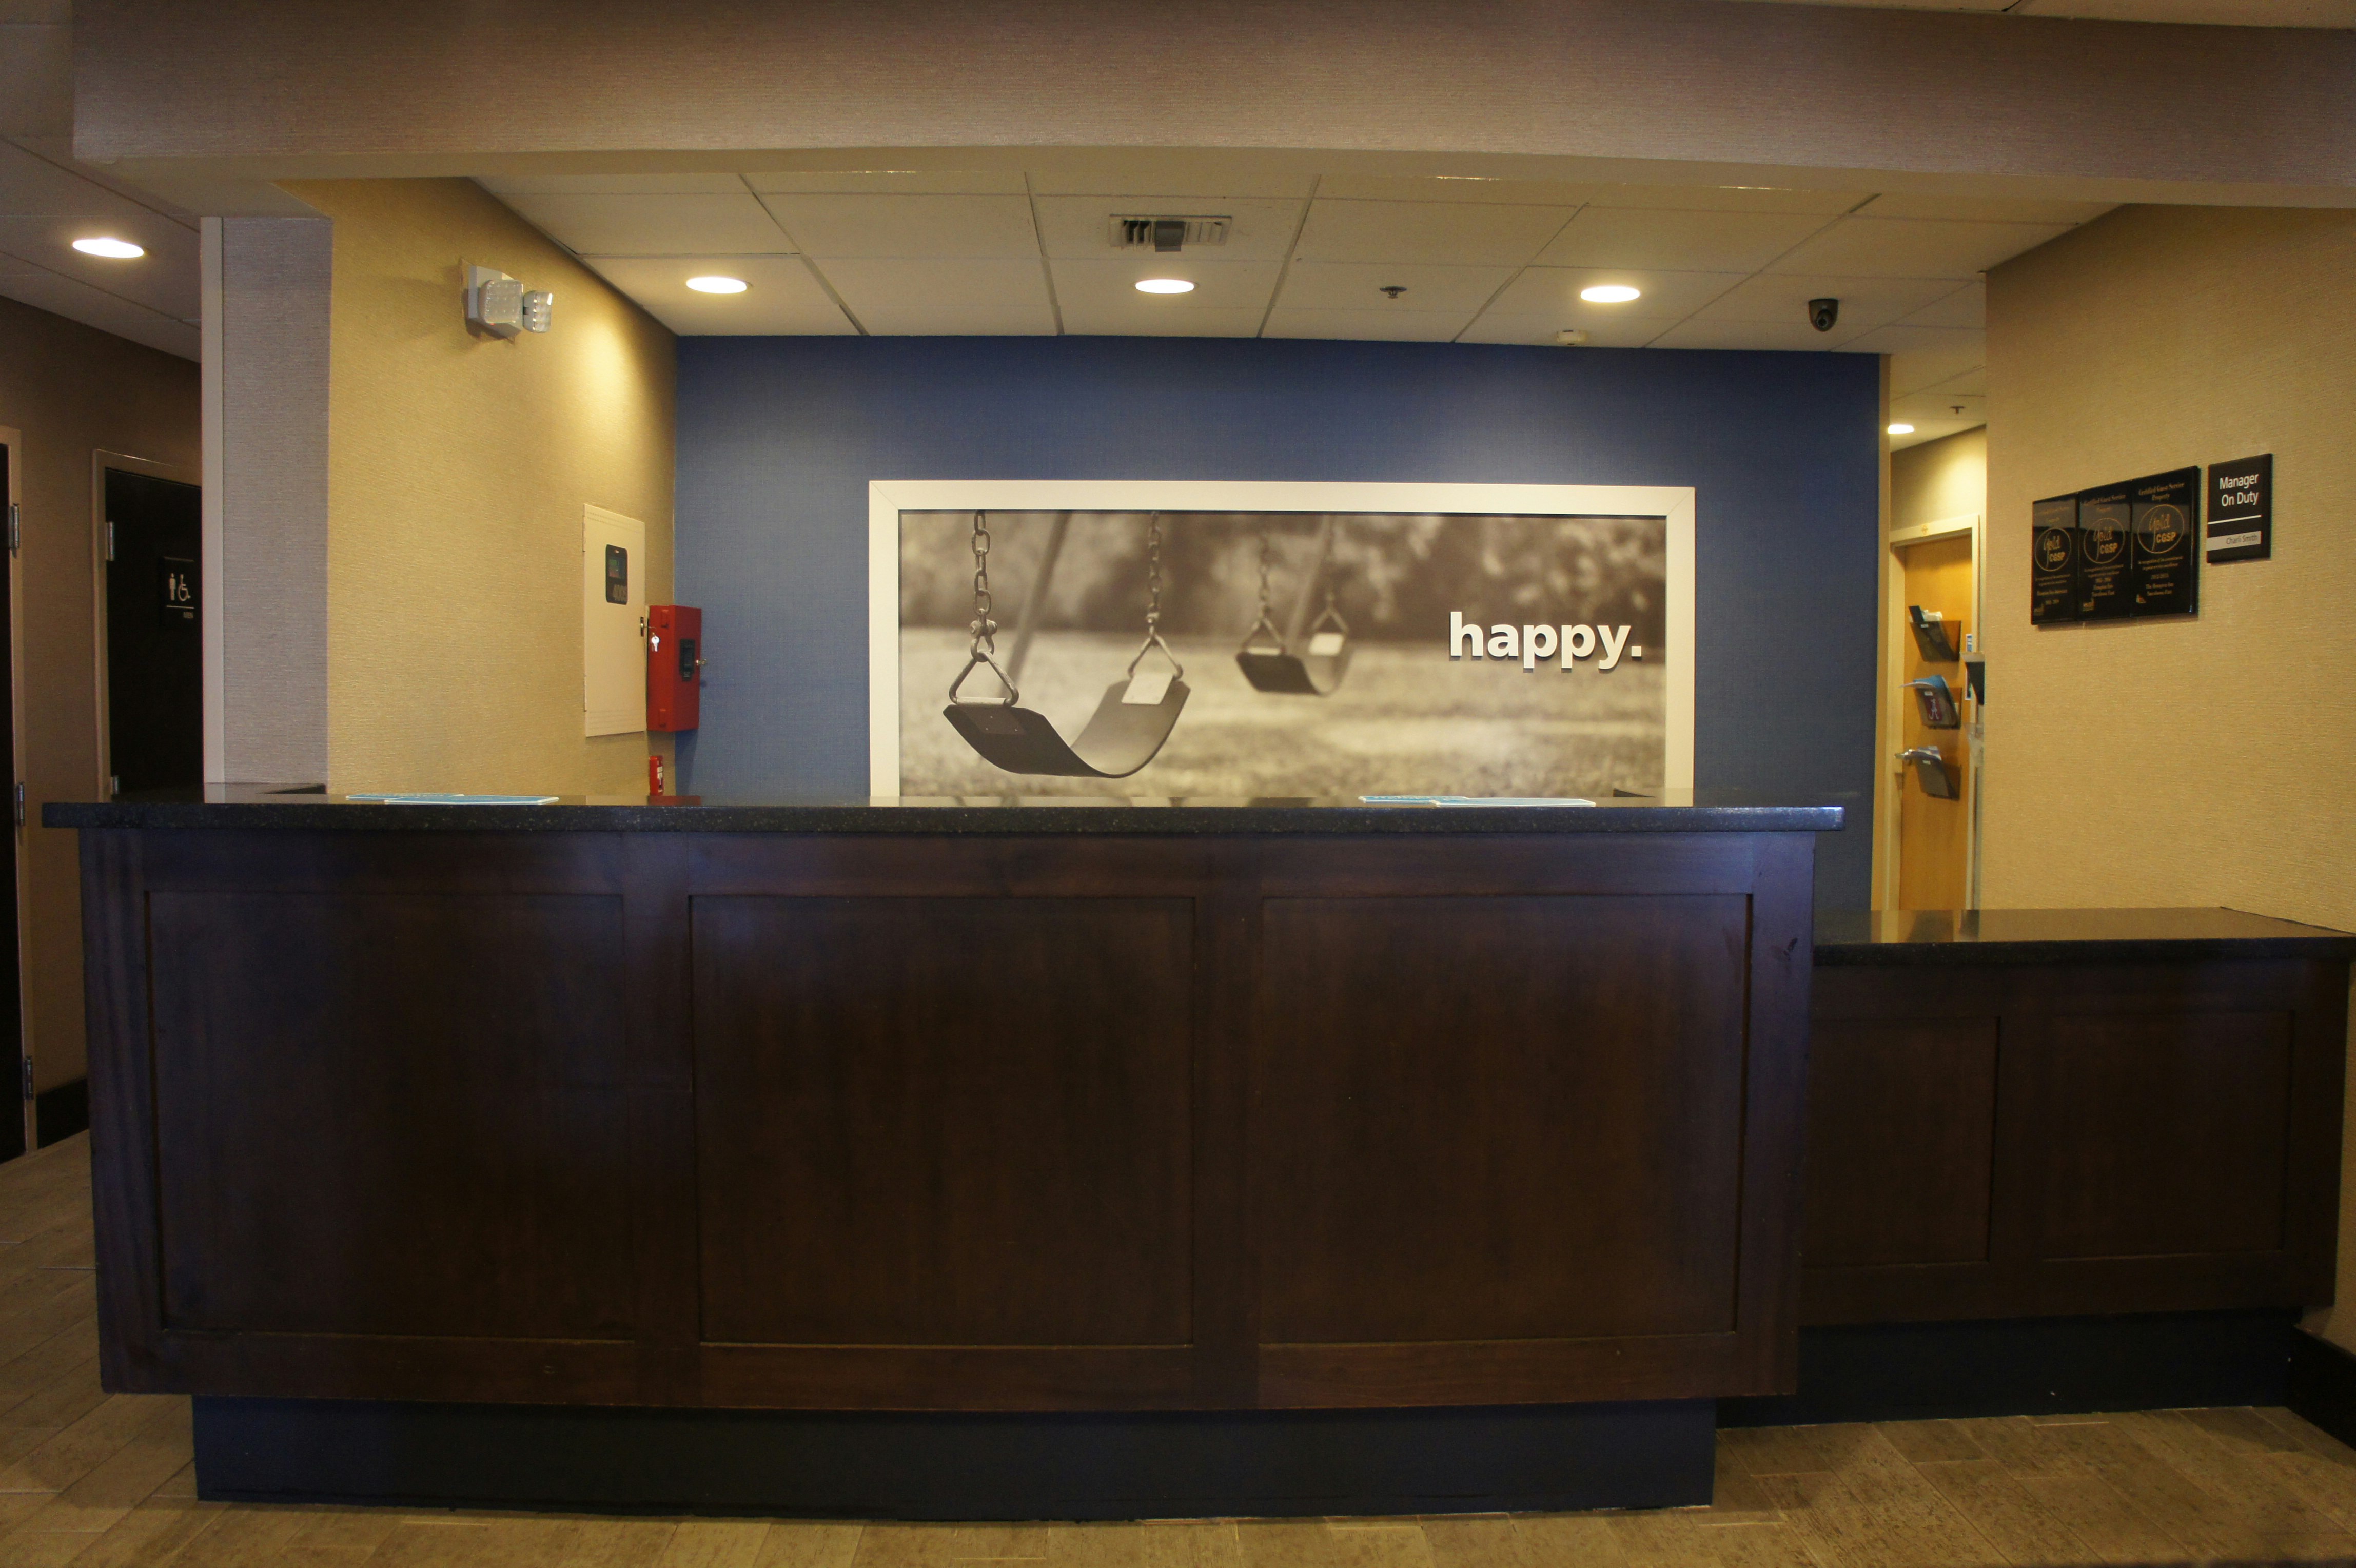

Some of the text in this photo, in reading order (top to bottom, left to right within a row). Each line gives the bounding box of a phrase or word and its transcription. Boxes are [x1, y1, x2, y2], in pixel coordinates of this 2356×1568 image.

[2220, 474, 2259, 489] Manager
[2222, 491, 2259, 507] On Duty
[2156, 532, 2176, 543] CGSP
[2100, 543, 2118, 554] CGSP
[1450, 611, 1642, 669] happy.
